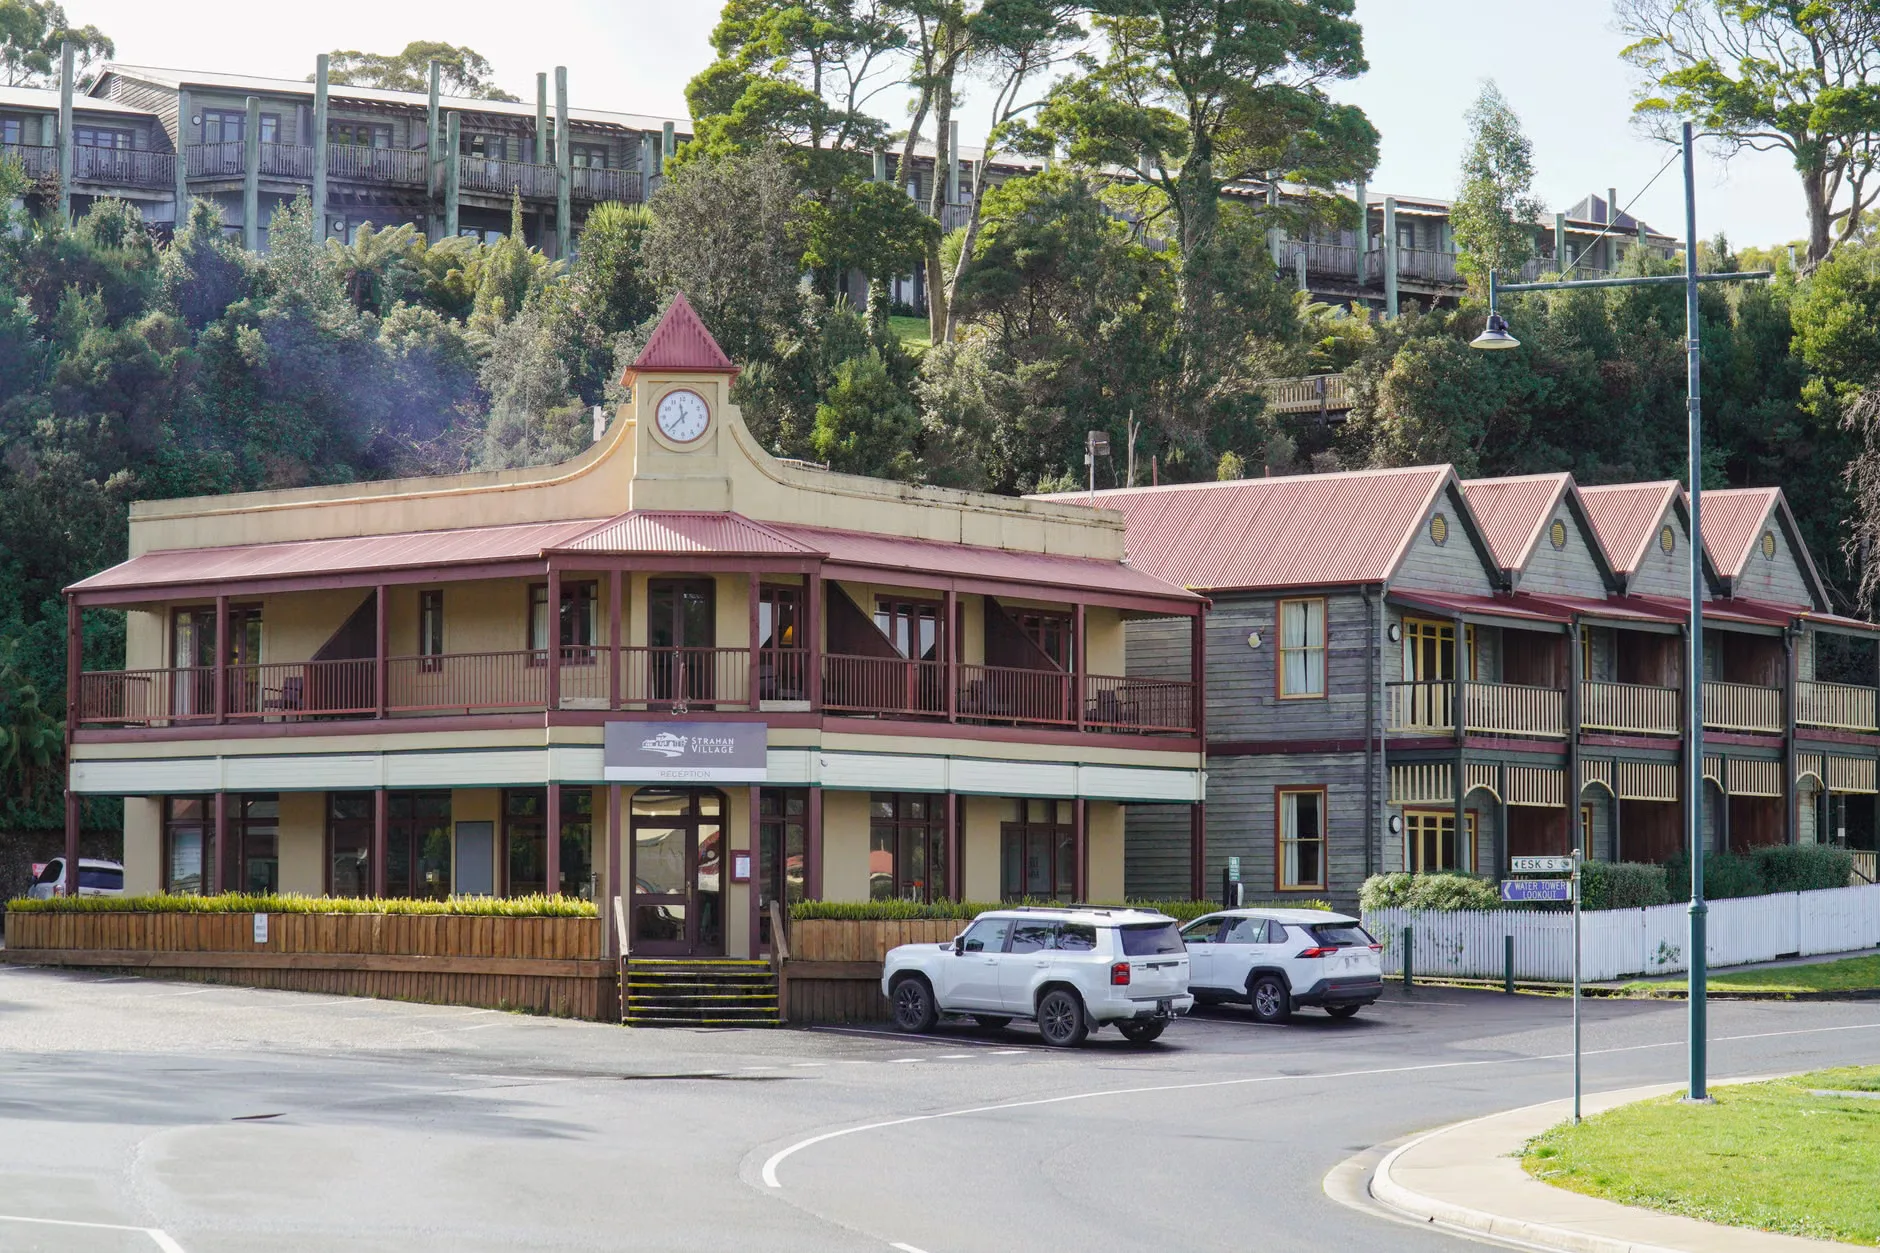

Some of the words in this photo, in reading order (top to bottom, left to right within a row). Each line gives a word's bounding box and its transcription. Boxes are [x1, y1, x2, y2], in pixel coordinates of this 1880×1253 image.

[691, 737, 734, 745] STRAHAN
[691, 745, 734, 753] VILLAGE
[660, 770, 711, 778] RECEPTION
[1521, 860, 1541, 869] ESK
[1514, 881, 1538, 891] WATER
[1541, 881, 1566, 891] TOWER
[1523, 890, 1556, 899] LOOKOUT
